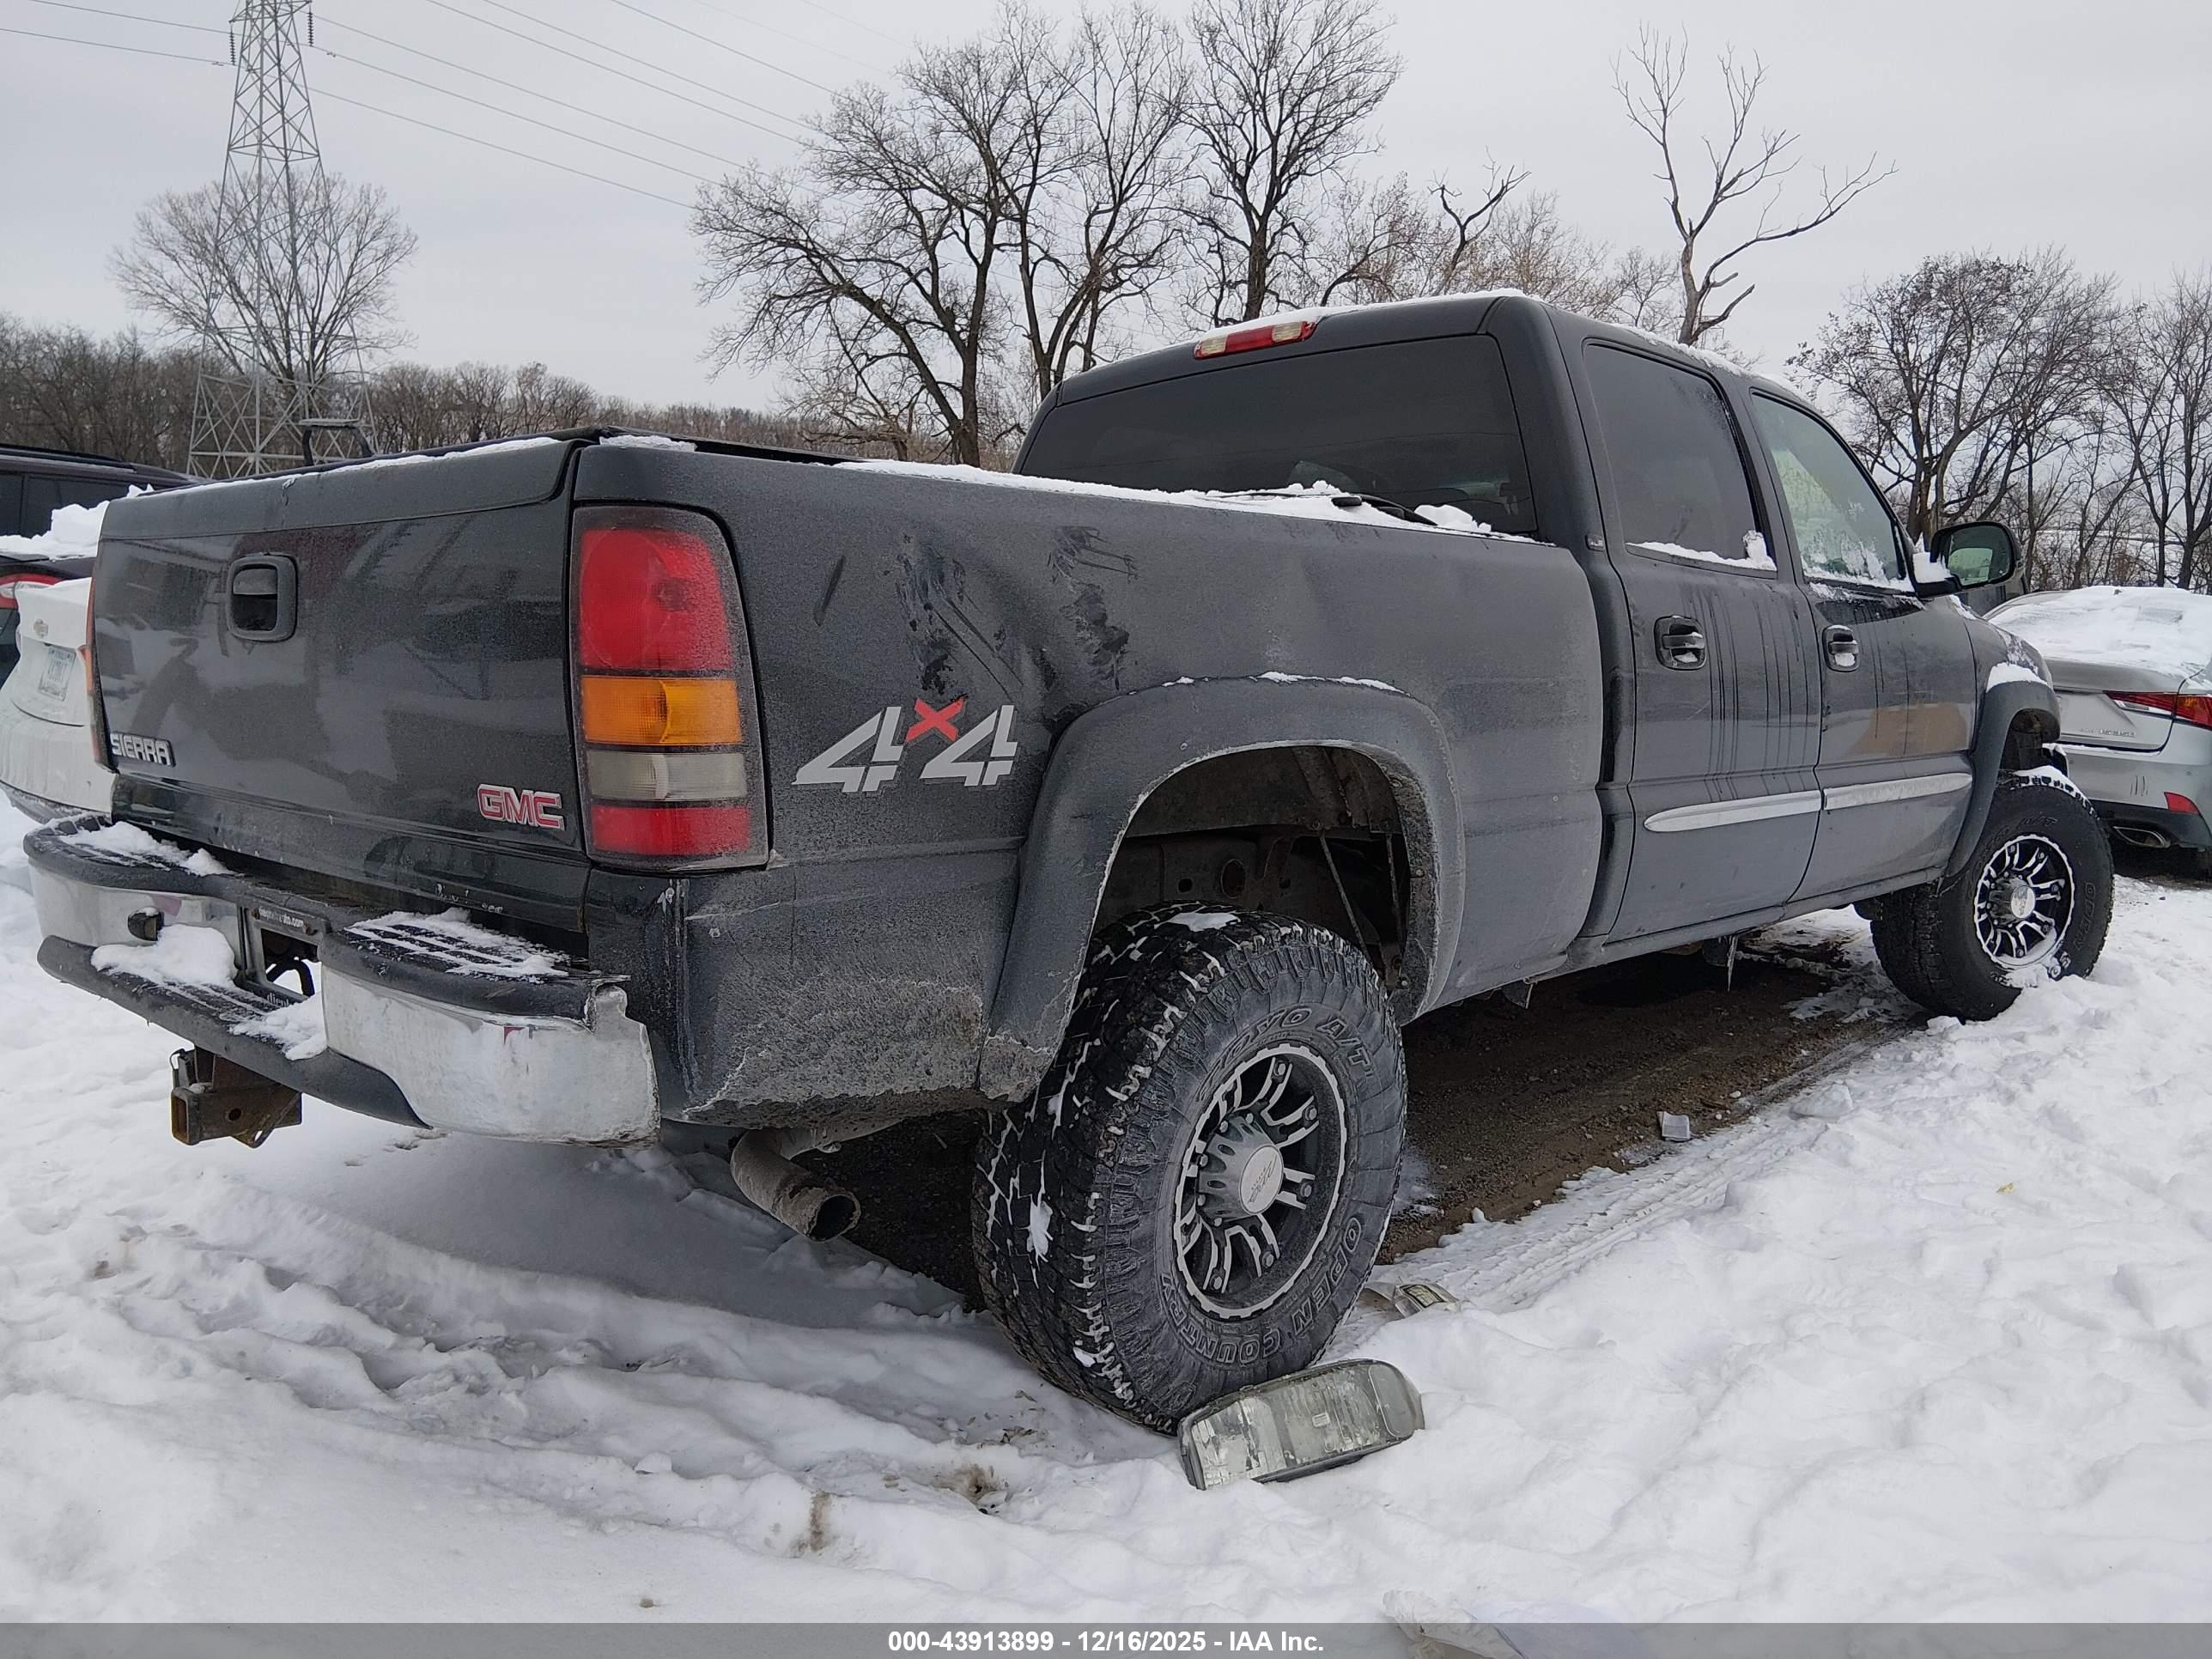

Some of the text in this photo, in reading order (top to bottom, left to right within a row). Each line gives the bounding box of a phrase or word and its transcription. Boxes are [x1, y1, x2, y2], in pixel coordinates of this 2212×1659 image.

[109, 732, 171, 766] SIERRA
[477, 783, 565, 830] GMC
[1161, 1217, 1362, 1364] OPEN COUNTRY
